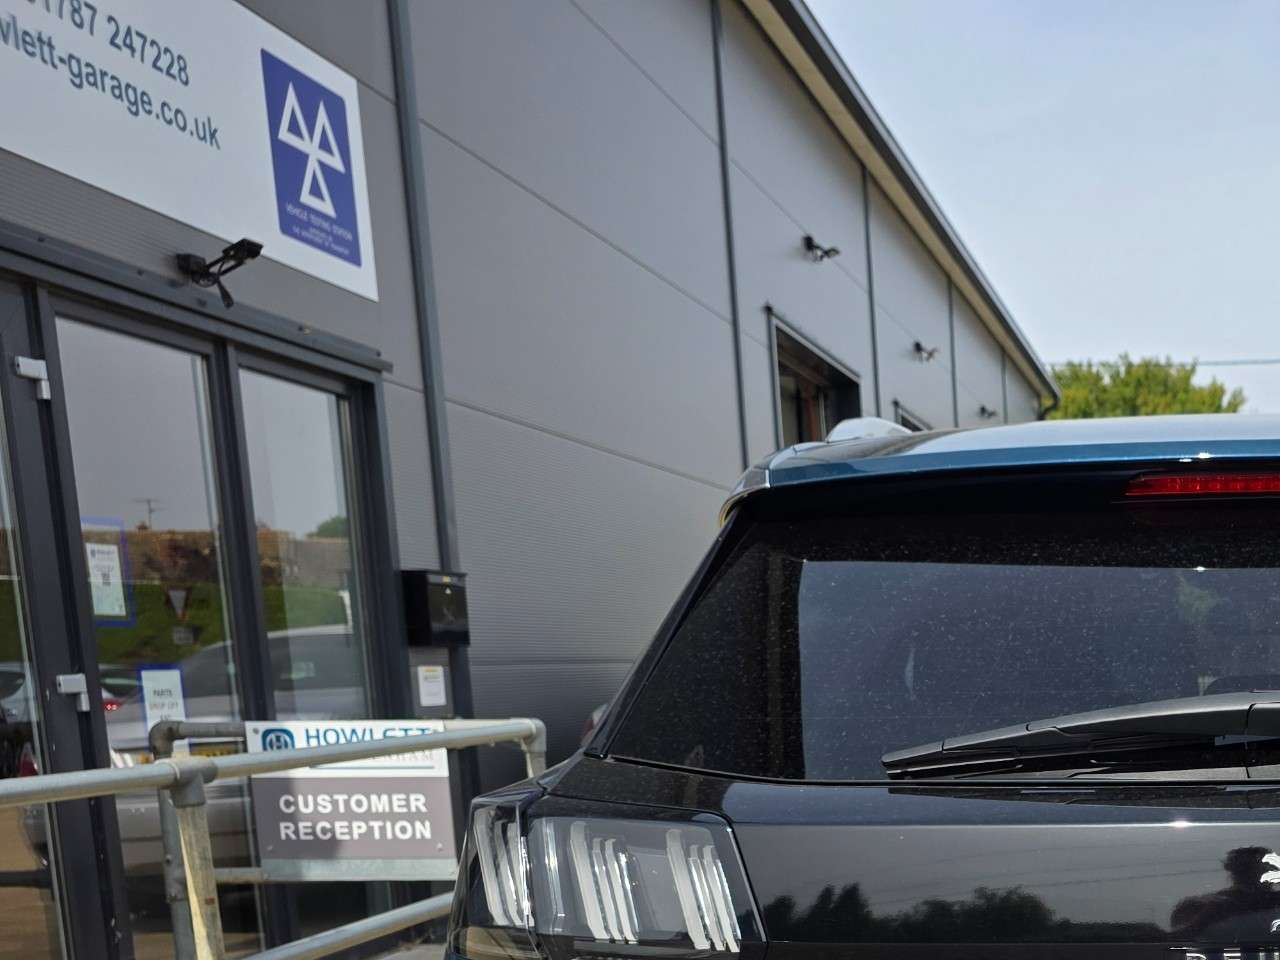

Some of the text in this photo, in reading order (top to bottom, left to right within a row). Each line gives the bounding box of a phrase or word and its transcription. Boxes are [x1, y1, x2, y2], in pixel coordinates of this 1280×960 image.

[106, 14, 190, 87] 247228
[279, 793, 428, 814] CUSTOMER
[279, 820, 432, 840] RECEPTION
